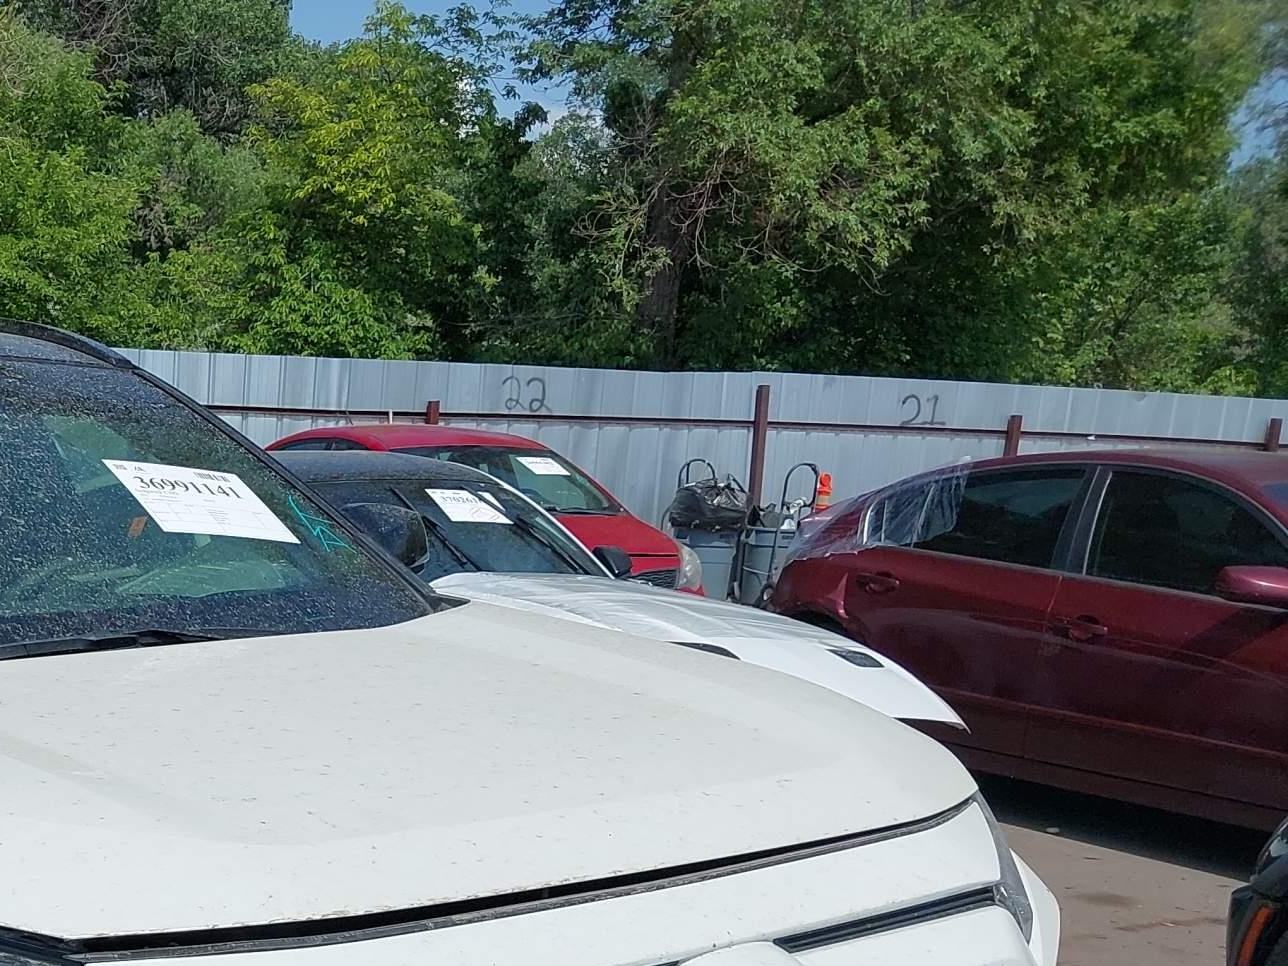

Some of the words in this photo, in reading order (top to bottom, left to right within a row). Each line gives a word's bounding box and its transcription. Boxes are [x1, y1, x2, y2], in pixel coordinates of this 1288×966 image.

[502, 376, 552, 413] 22
[899, 394, 946, 425] 21
[133, 476, 243, 499] 36991141
